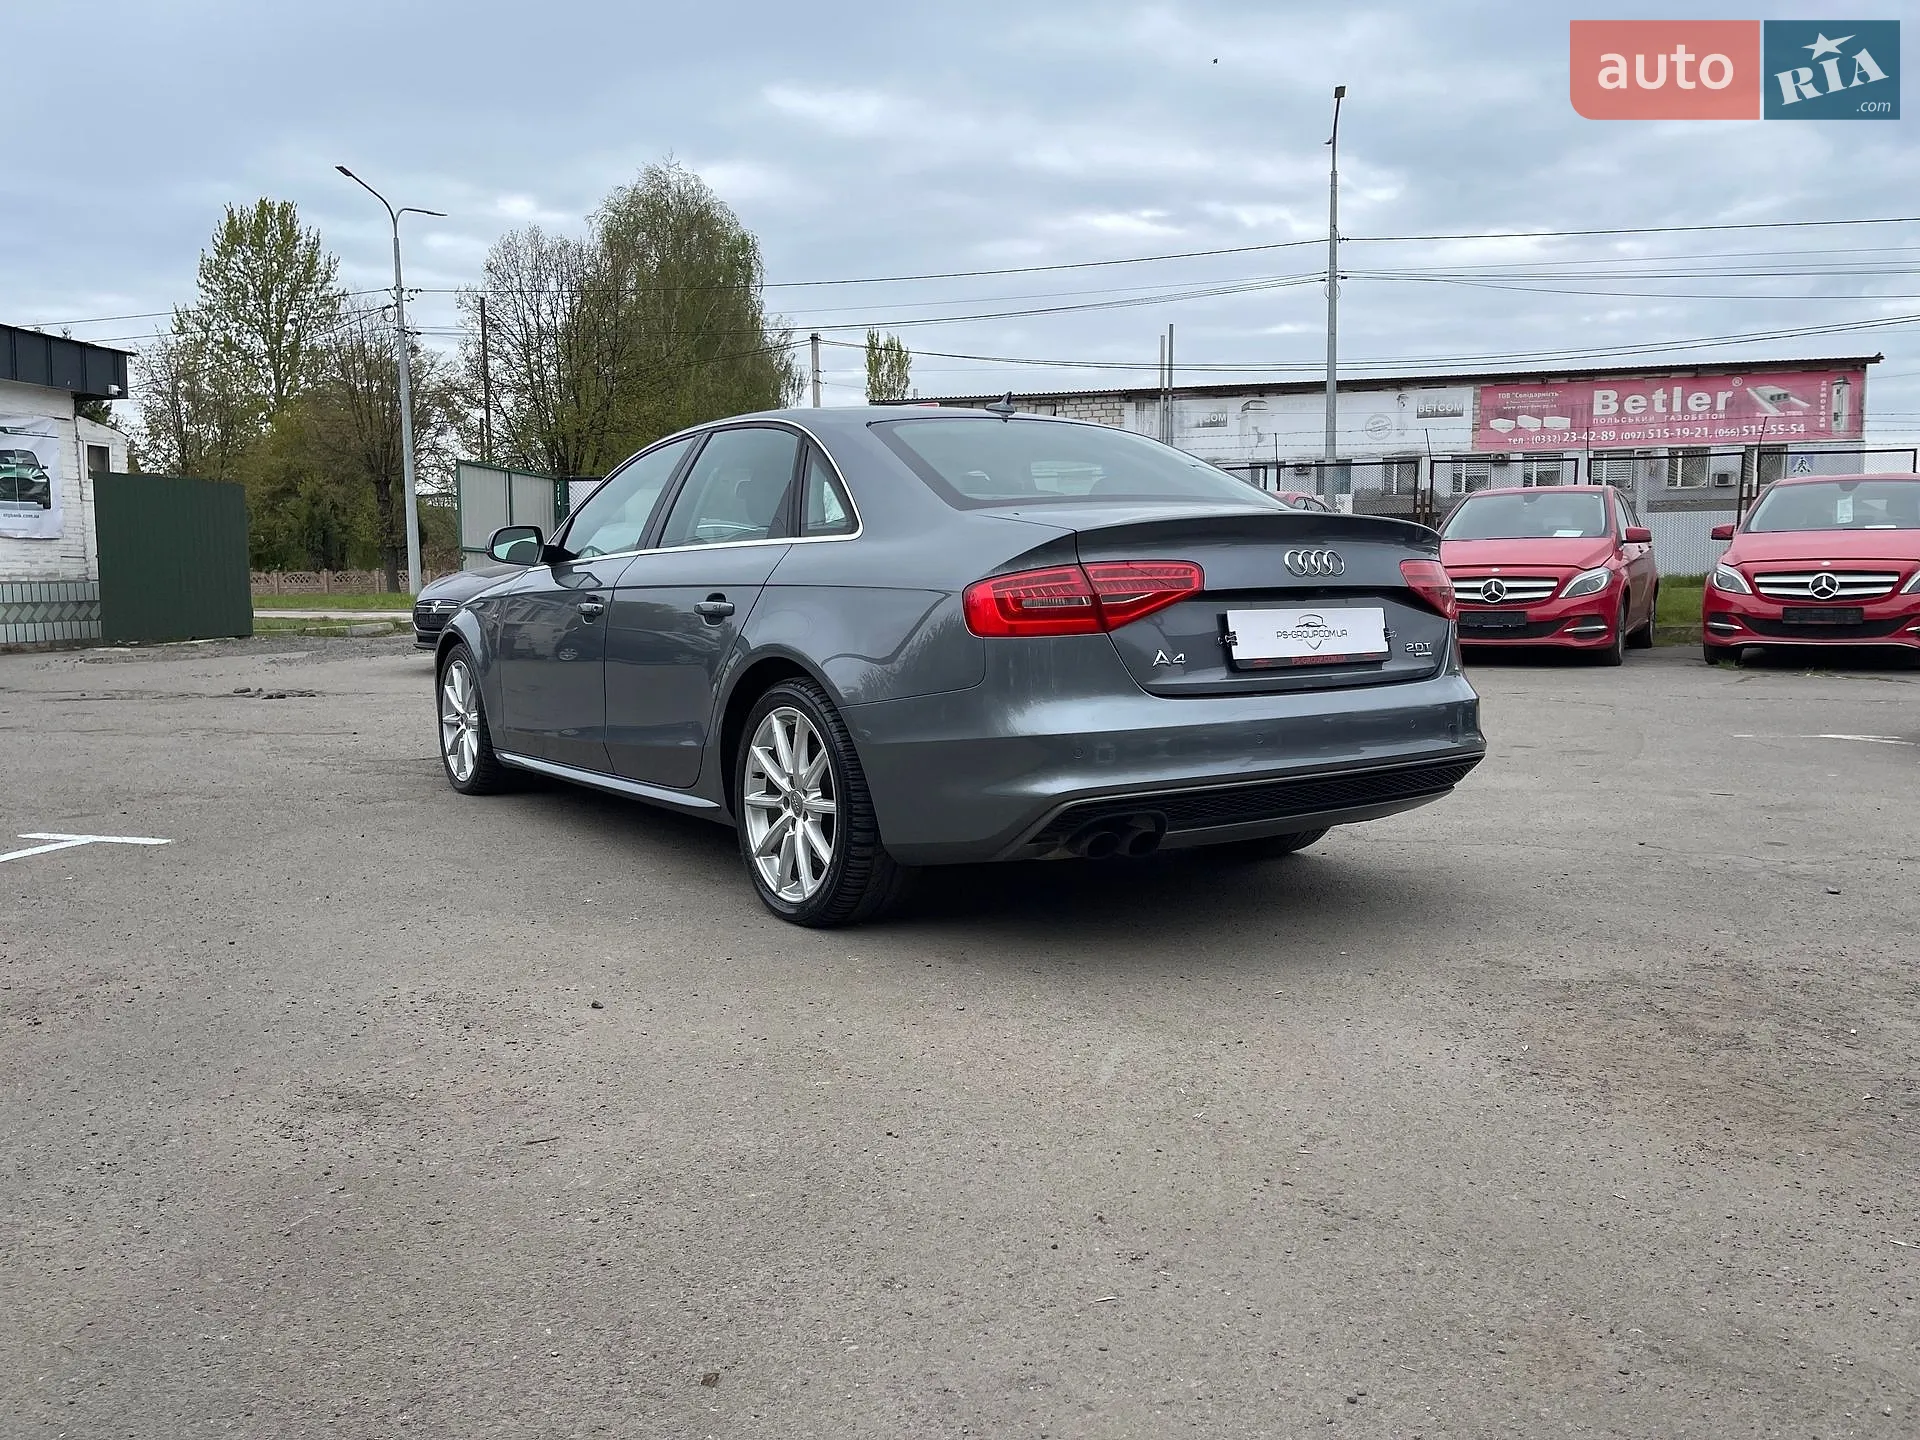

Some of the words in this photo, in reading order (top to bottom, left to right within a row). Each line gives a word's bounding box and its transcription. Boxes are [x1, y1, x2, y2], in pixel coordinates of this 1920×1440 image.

[1418, 403, 1464, 413] BETCOM
[1593, 386, 1734, 416] Betler
[1664, 413, 1727, 422] ГАЗОБЕТОН
[1531, 434, 1561, 444] (0332)
[1621, 431, 1646, 441] (097)
[1742, 423, 1806, 436] 515-55-54
[1152, 649, 1186, 667] A4
